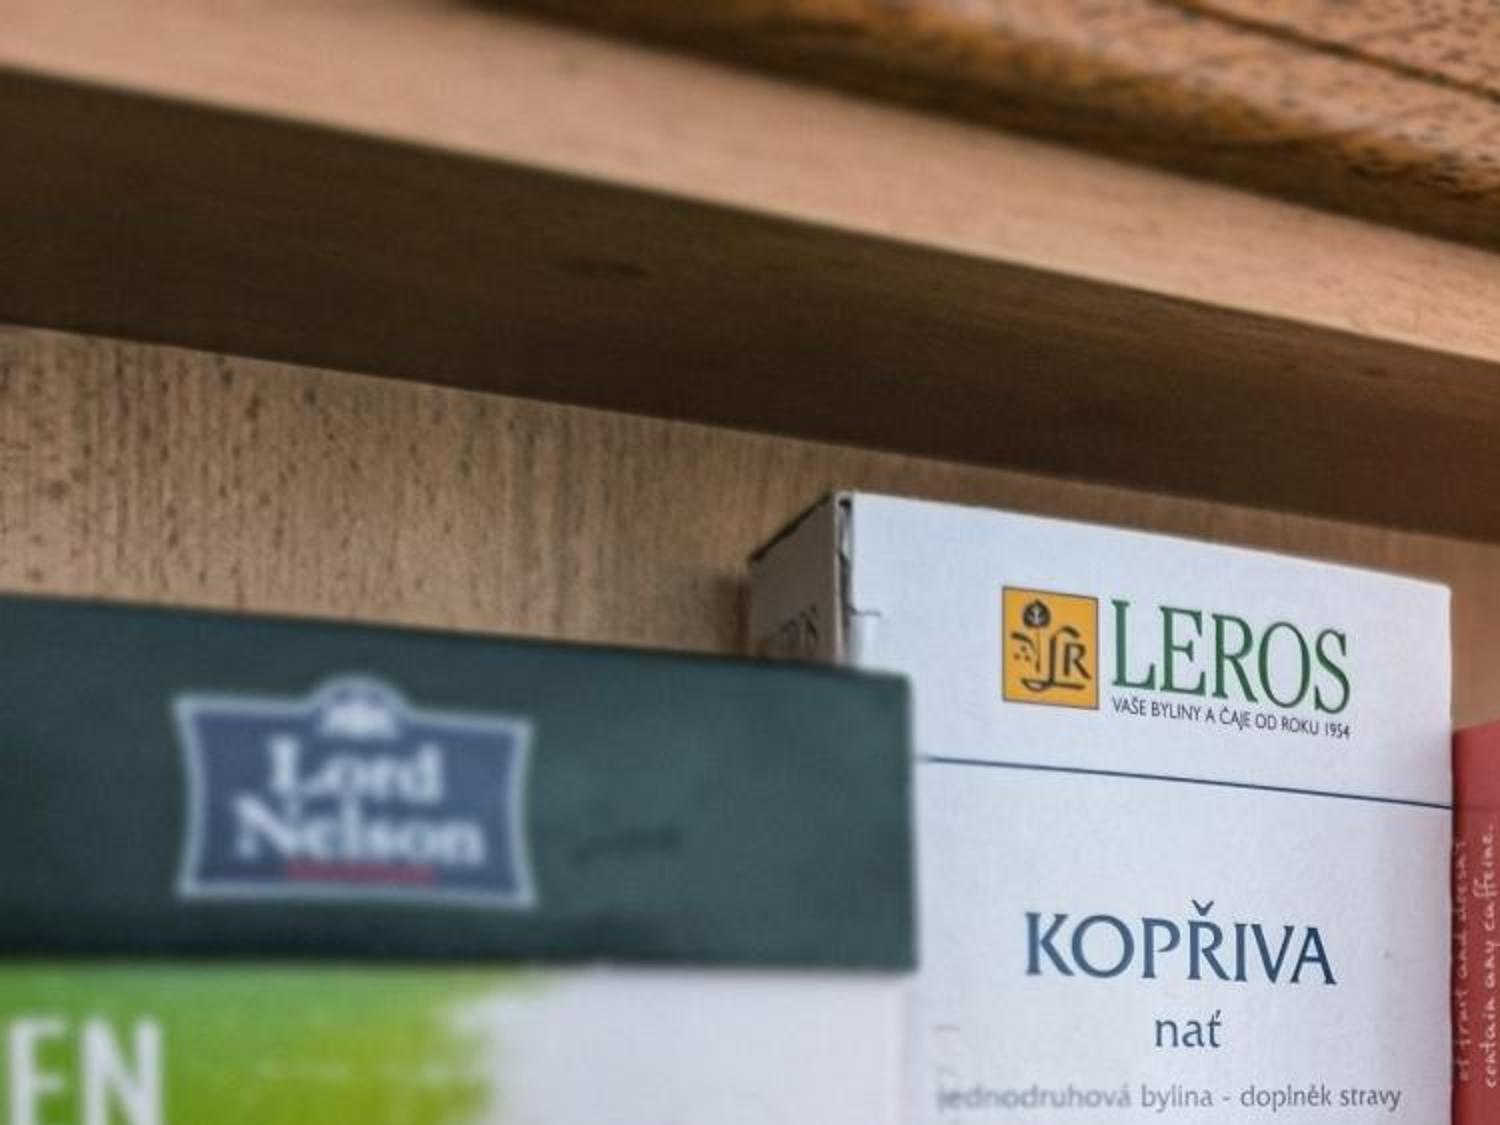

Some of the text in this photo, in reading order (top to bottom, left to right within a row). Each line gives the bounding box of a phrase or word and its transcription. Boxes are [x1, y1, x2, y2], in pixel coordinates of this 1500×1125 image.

[1111, 598, 1351, 715] LEROS
[1112, 695, 1351, 739] VAŠE BYLINY A ČAJE OD ROKU 1954
[267, 732, 443, 804] Lord
[233, 794, 487, 867] Nelson
[1025, 900, 1337, 986] KOPŘIVA
[1155, 1010, 1222, 1049] nať
[1479, 996, 1498, 1088] contain
[1141, 1085, 1213, 1113] bylina
[1240, 1085, 1332, 1112] doplněk
[1340, 1087, 1402, 1112] stravy
